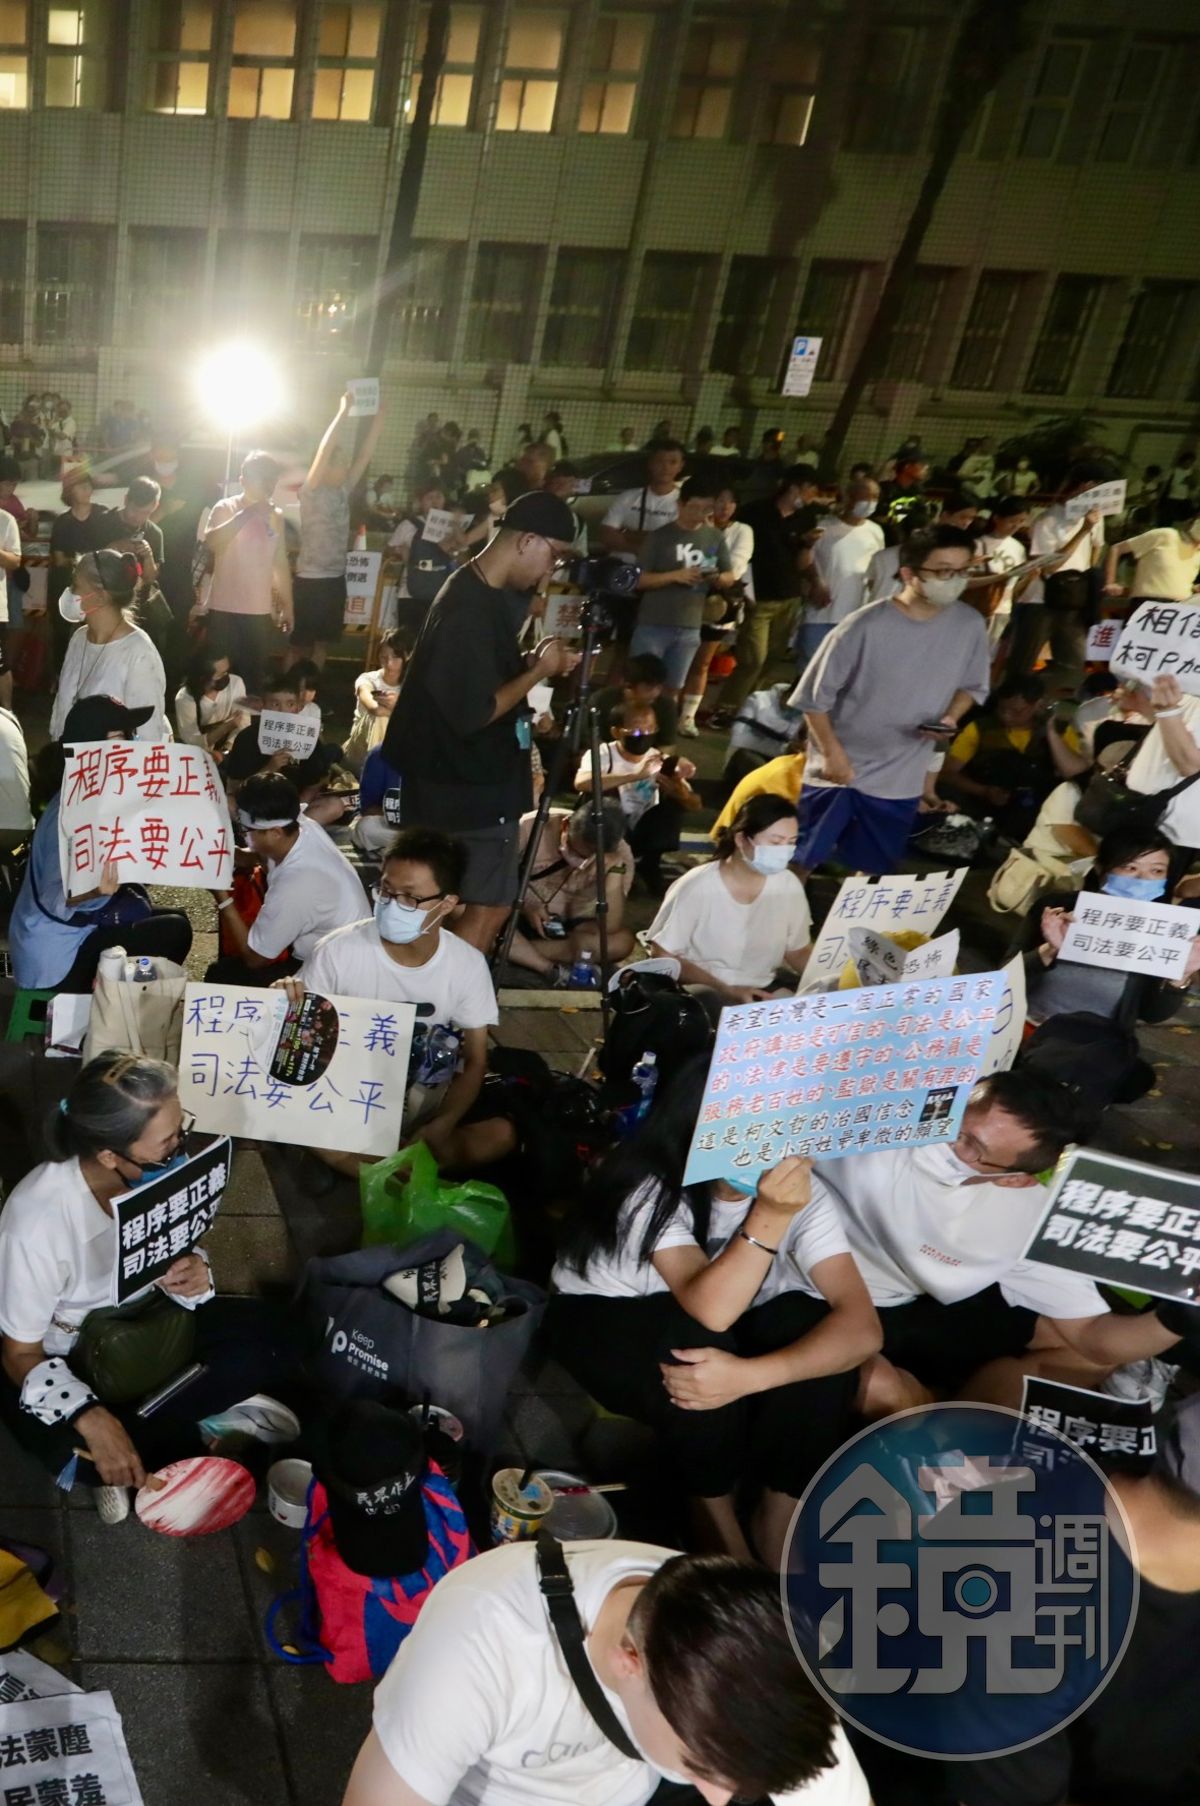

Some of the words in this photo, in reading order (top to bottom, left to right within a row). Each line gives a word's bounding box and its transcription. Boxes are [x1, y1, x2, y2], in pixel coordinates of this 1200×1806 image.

[262, 735, 313, 753] 司法要公平
[264, 719, 316, 738] 程序要正義
[67, 745, 221, 806] 程序要正義
[74, 816, 231, 878] 司法要公平
[832, 880, 955, 919] 程序要正義
[1081, 908, 1191, 940] 程序要正義
[1072, 934, 1180, 965] 司法要公平
[697, 1099, 915, 1151] 這是柯文哲的治國信念
[122, 1163, 226, 1250] 程序要正義
[1058, 1179, 1200, 1241] 程序要正
[1042, 1213, 1200, 1276] 司法要公平
[348, 1342, 389, 1372] Promise
[351, 1328, 375, 1350] Keep
